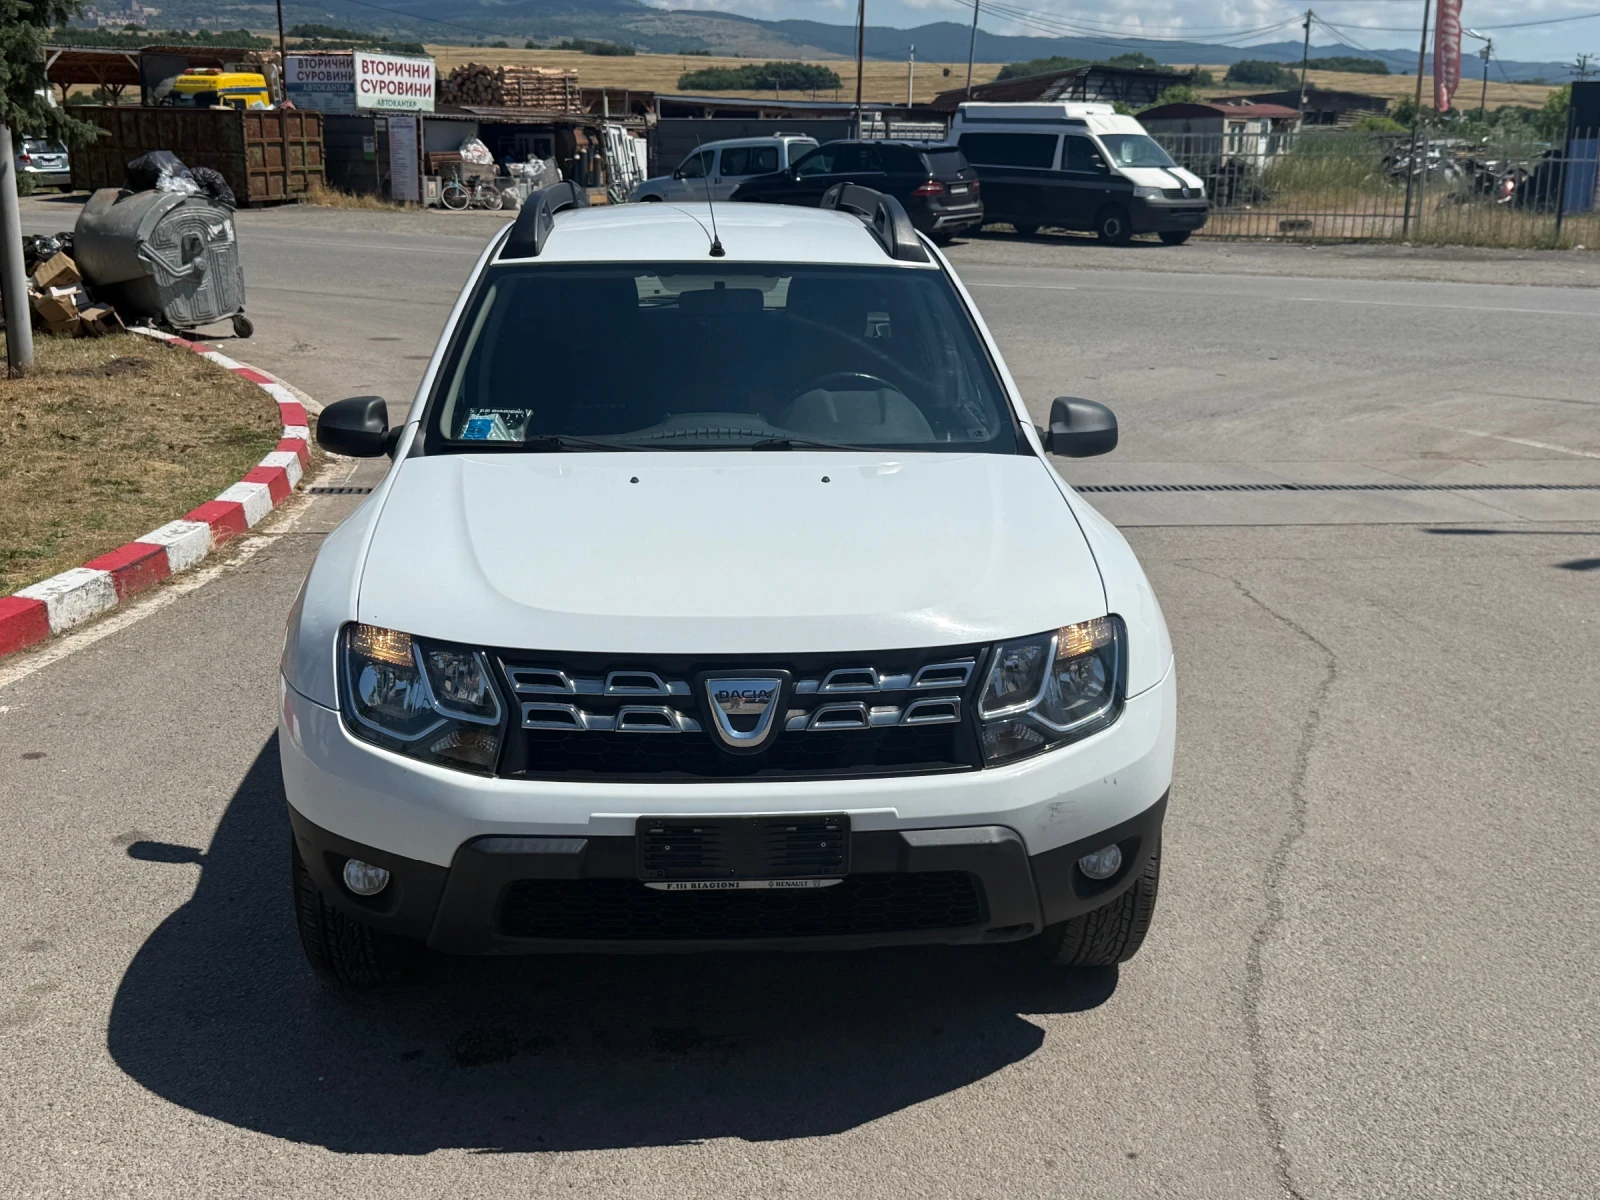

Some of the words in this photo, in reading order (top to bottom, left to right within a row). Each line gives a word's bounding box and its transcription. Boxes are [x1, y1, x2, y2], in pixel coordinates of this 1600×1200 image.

[298, 58, 354, 69] ВТОРИЧНИ
[361, 59, 430, 79] ВТОРИЧНИ
[303, 84, 350, 92] АВТОКАНТАР
[360, 79, 431, 98] СУРОВИНИ
[377, 98, 417, 108] АВТОКАНТАР
[718, 689, 769, 699] DACIA
[690, 881, 740, 889] BIAGIONI
